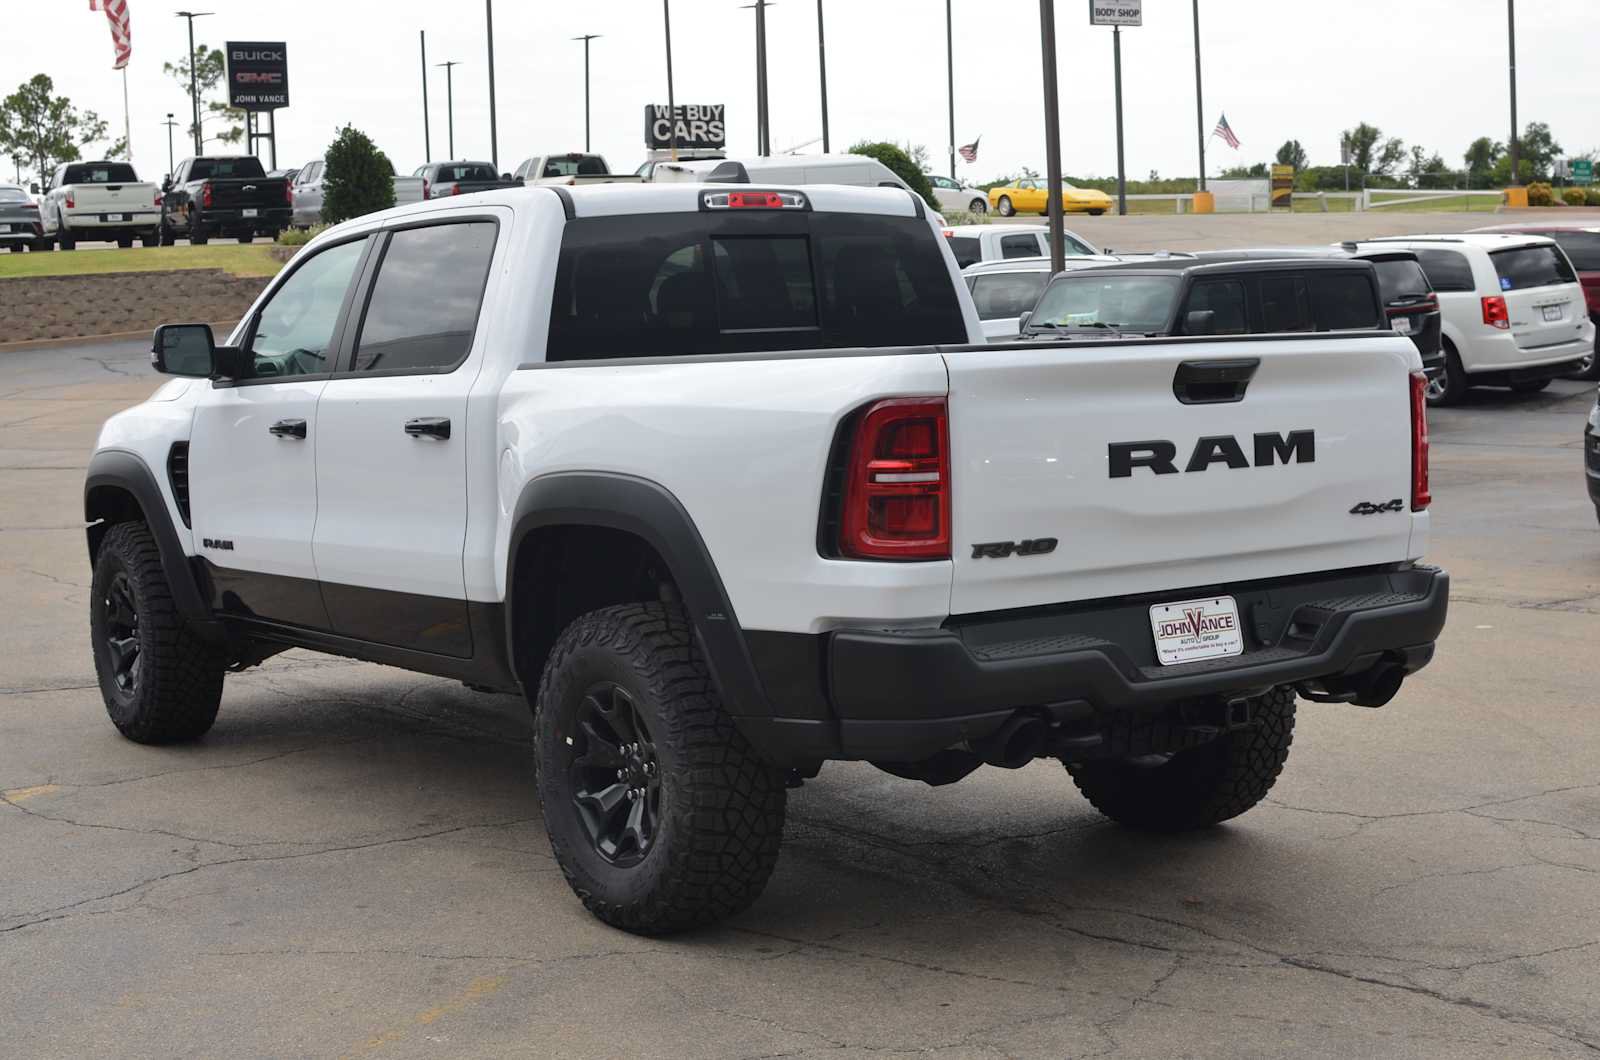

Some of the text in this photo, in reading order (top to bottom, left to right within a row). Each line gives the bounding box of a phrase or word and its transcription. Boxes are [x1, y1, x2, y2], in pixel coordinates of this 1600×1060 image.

[1095, 8, 1140, 17] BODY SHOP
[232, 51, 283, 60] BUICK
[236, 73, 282, 82] GMC
[234, 95, 285, 103] JOHN VANCE
[653, 104, 723, 120] WE BUY
[653, 119, 724, 142] CARS
[1108, 429, 1316, 478] RAM
[203, 538, 234, 551] RAM
[970, 537, 1058, 560] RHO
[1160, 610, 1233, 638] JOHN VANCE
